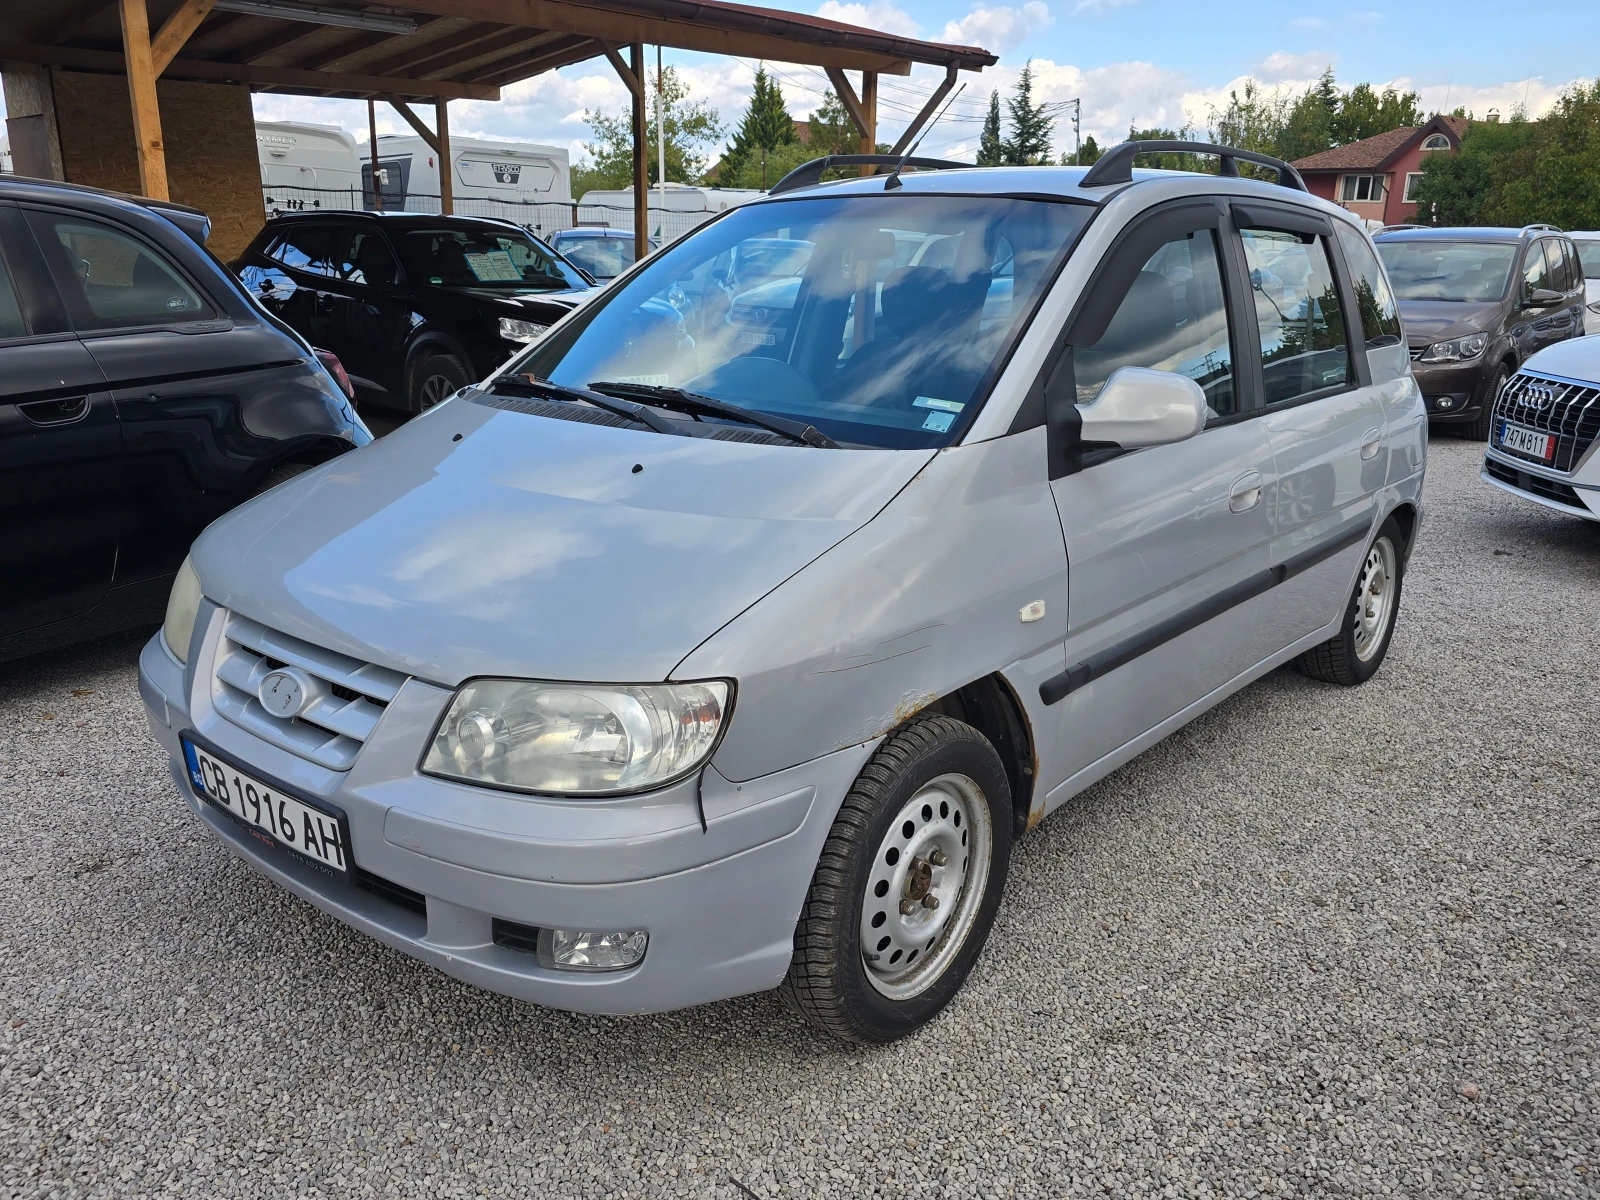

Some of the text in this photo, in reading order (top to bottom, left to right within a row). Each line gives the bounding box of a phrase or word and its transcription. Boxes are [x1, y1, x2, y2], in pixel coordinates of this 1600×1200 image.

[1504, 427, 1544, 454] 747M811
[200, 755, 231, 806] CB
[233, 776, 296, 843] 1916
[303, 811, 343, 867] AH
